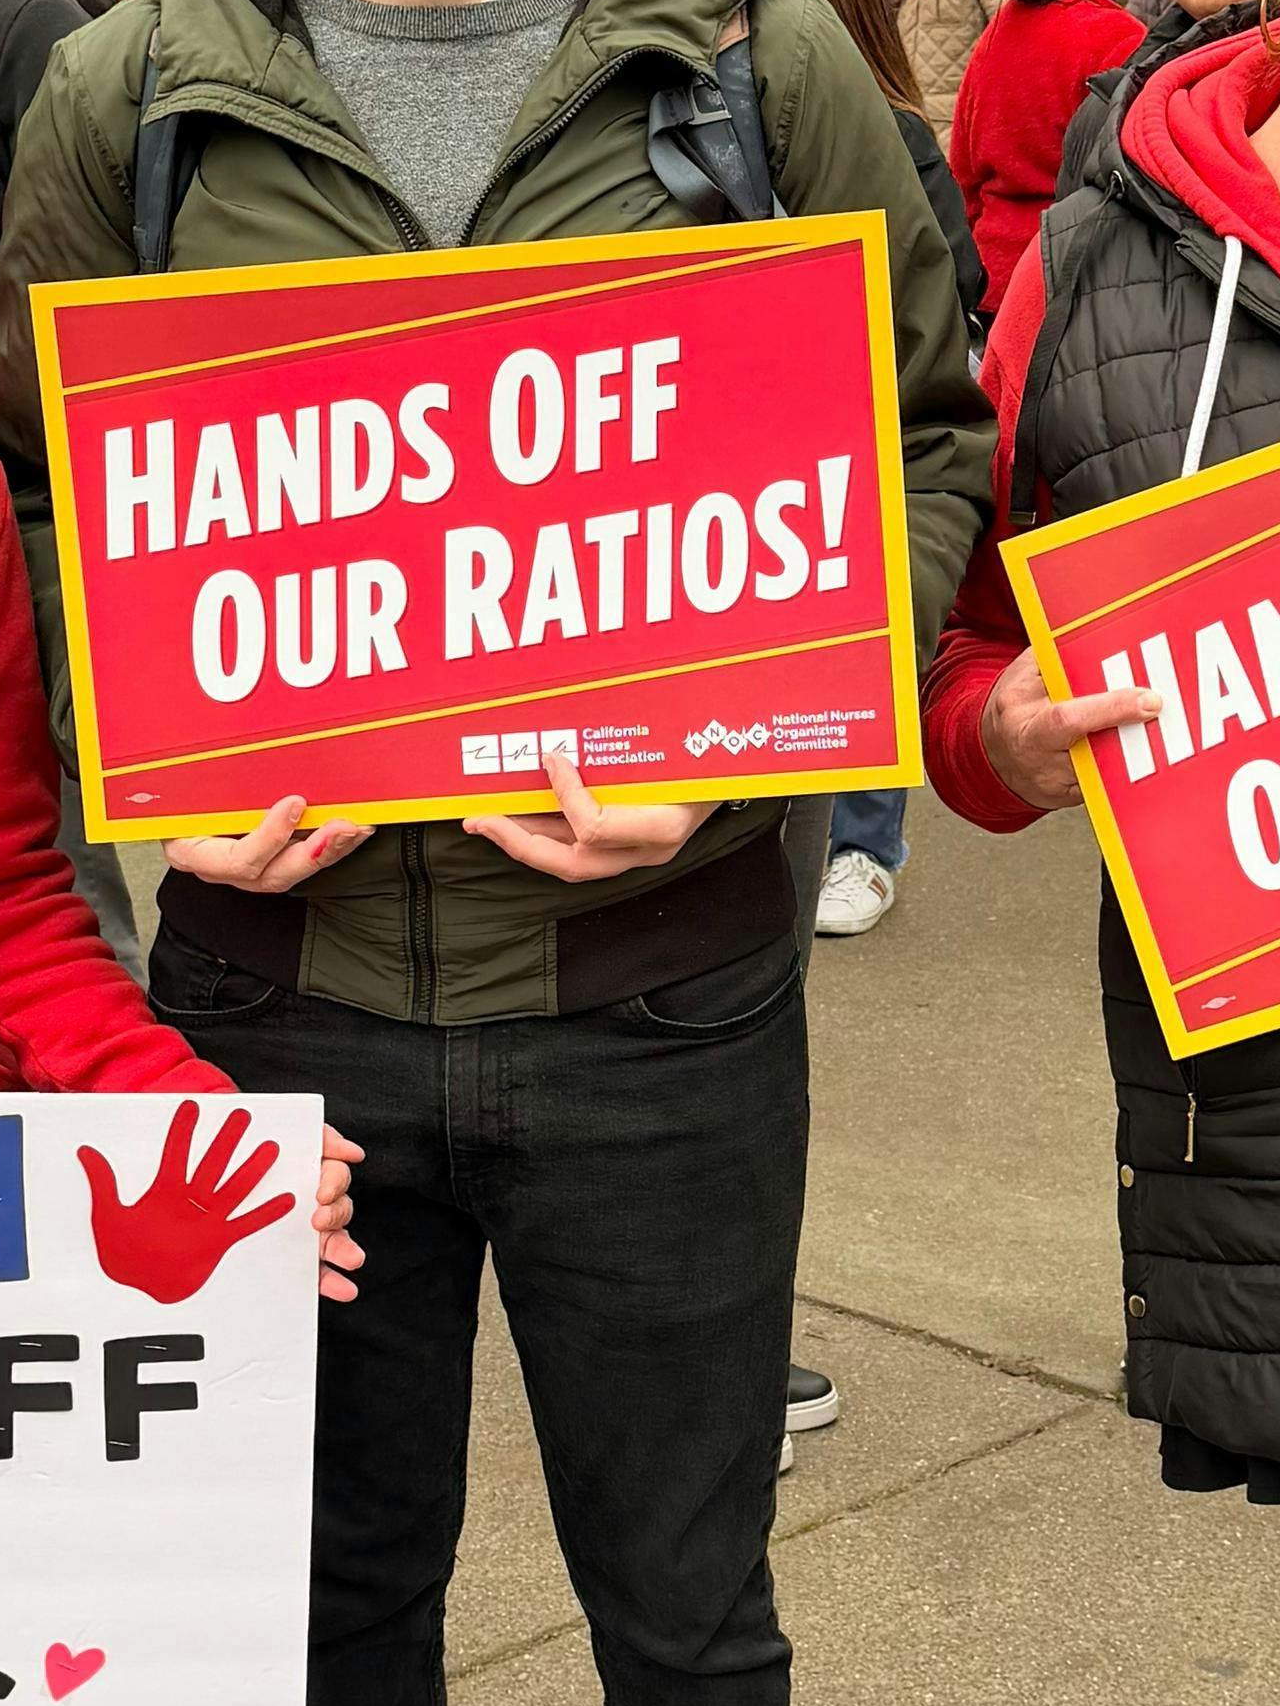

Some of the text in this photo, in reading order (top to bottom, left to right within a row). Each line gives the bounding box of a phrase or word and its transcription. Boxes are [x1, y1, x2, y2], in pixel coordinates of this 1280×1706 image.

[104, 336, 682, 562] HANDS OFF
[192, 455, 851, 704] OUR RATIOS!
[772, 707, 877, 727] National Nurses
[582, 724, 650, 740] California
[772, 724, 847, 741] Organizing
[583, 739, 631, 754] Nurses
[774, 736, 849, 753] Committee
[584, 749, 666, 767] Association
